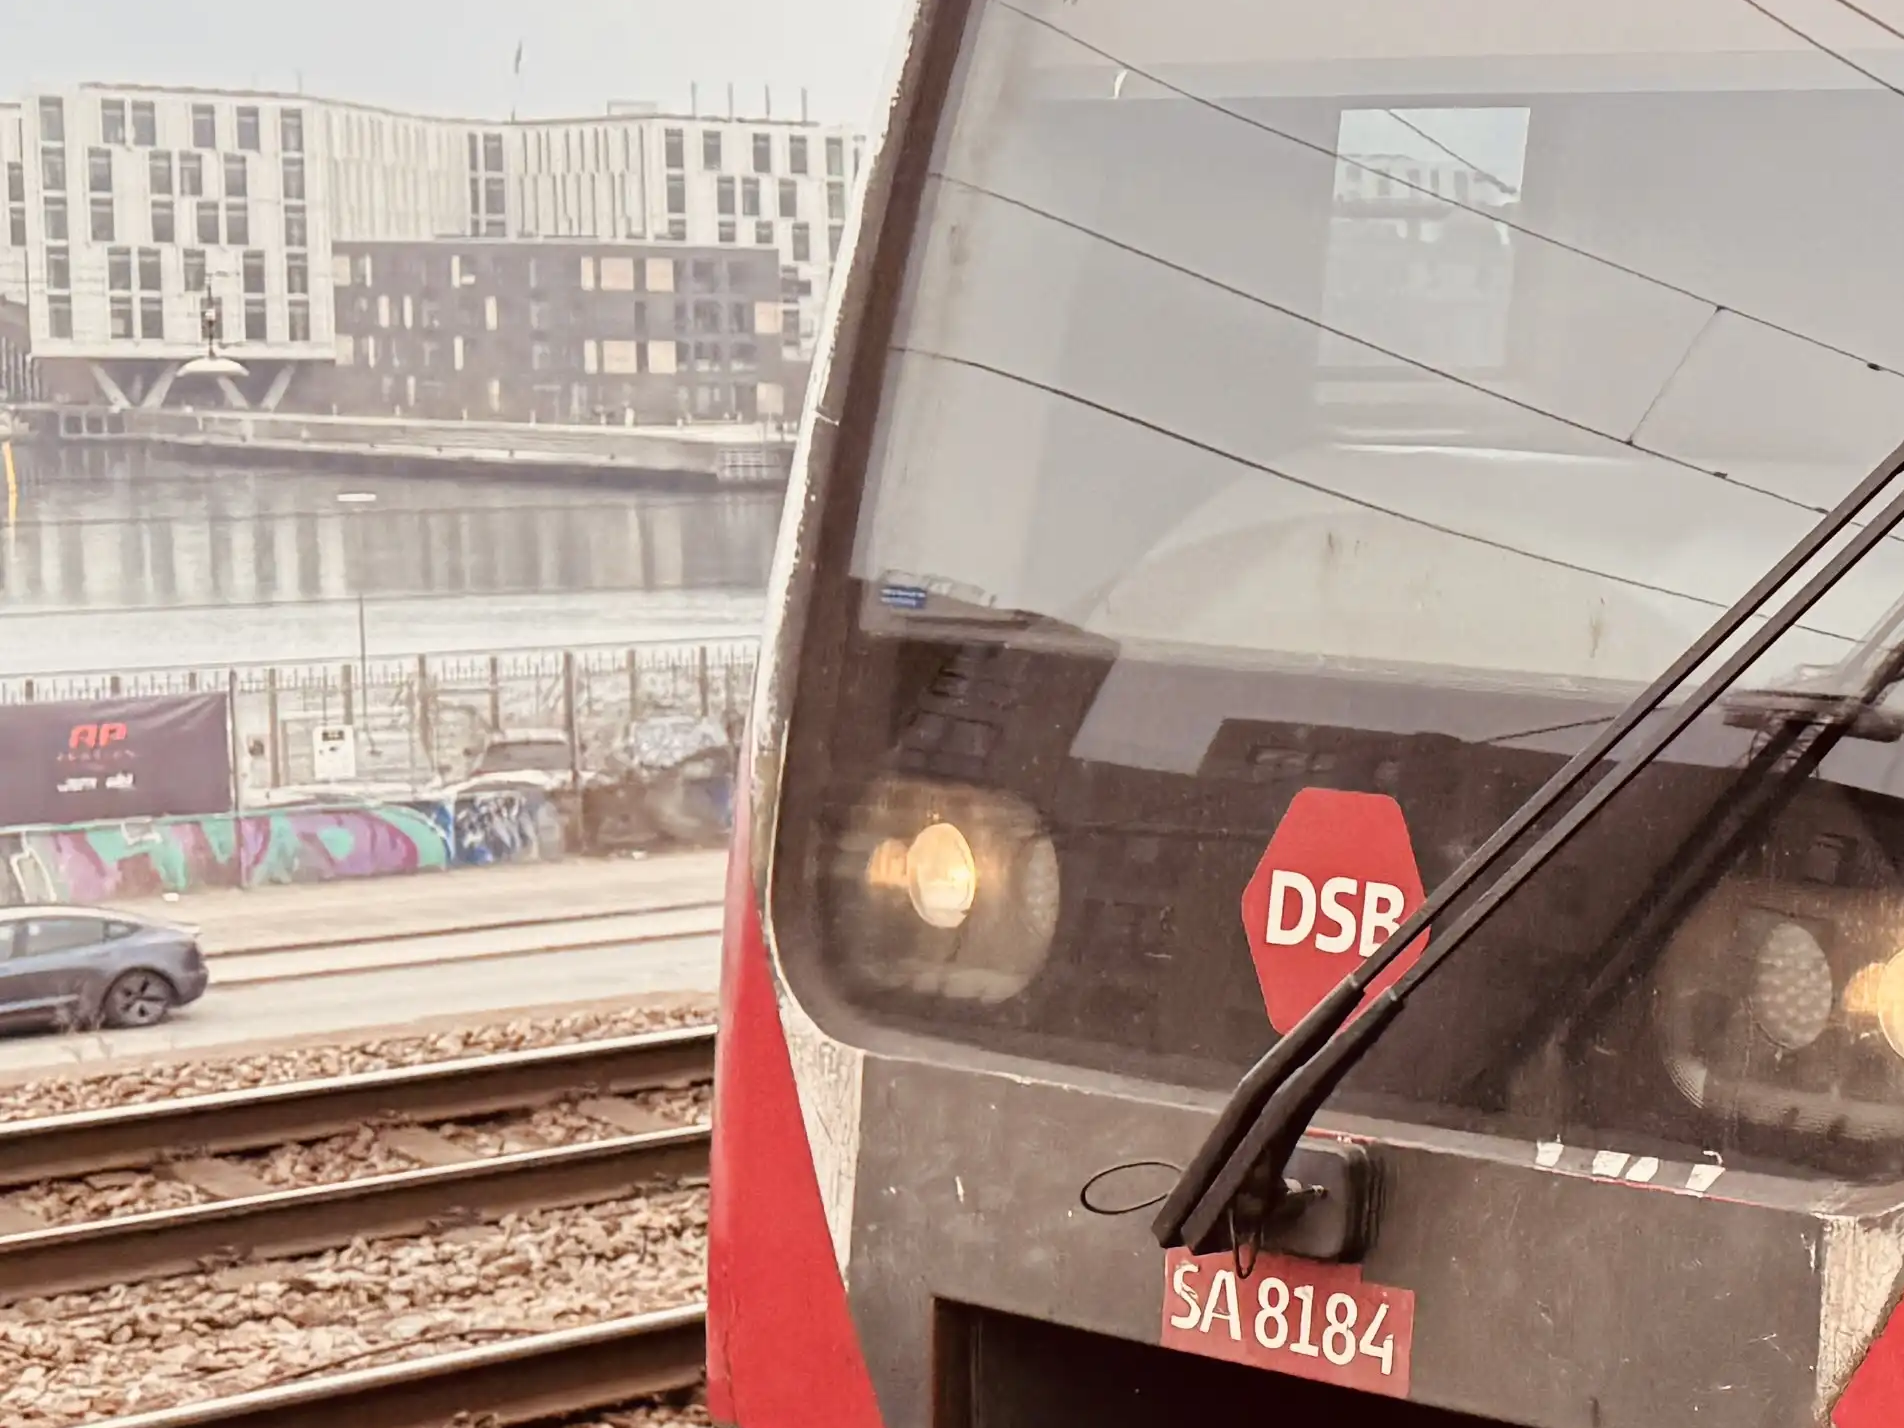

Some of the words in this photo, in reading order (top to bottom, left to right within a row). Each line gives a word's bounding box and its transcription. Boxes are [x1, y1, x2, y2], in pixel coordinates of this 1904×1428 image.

[1264, 868, 1406, 958] DSB
[1169, 1262, 1242, 1343] SA
[1253, 1276, 1396, 1378] 8184
